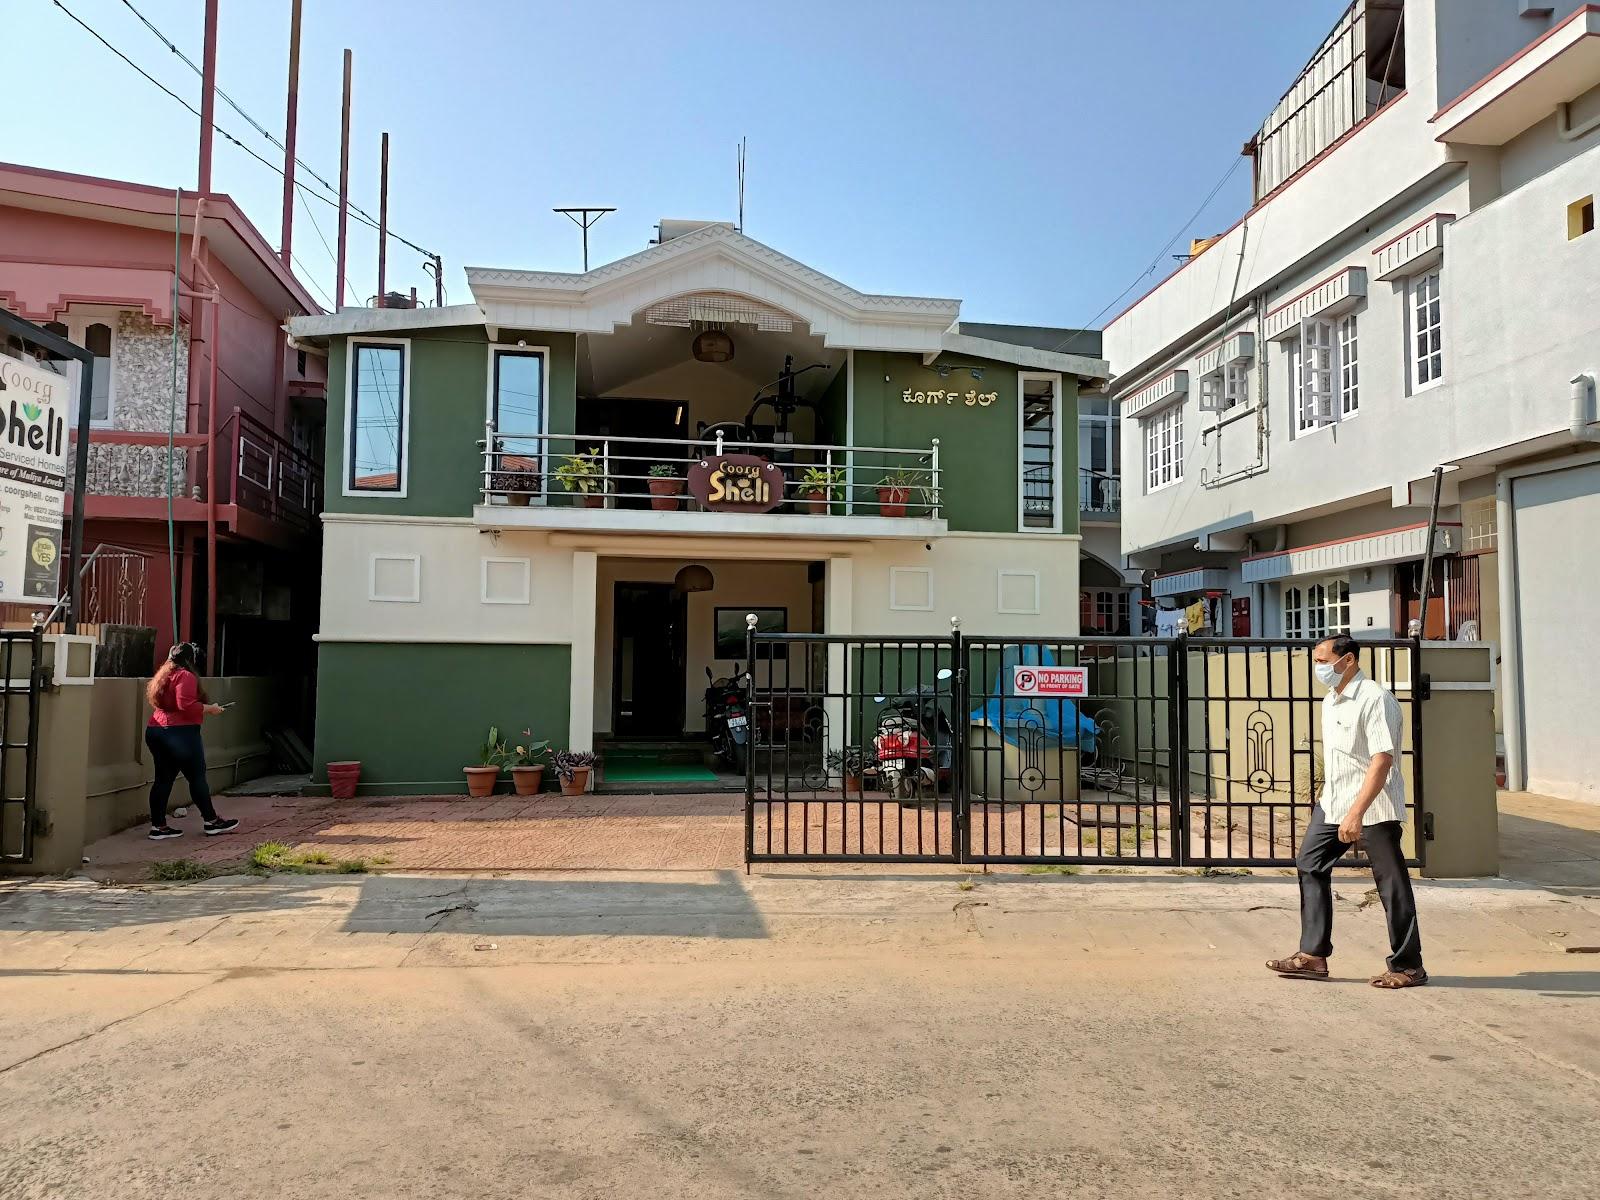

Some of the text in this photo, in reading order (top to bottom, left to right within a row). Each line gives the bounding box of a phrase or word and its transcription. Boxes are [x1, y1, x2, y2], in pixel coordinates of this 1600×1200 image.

[2, 361, 53, 405] Coorg
[0, 447, 65, 474] Serviced Homes
[719, 461, 761, 478] Coorg
[708, 470, 770, 503] Shell
[1038, 673, 1082, 684] NO PARKING
